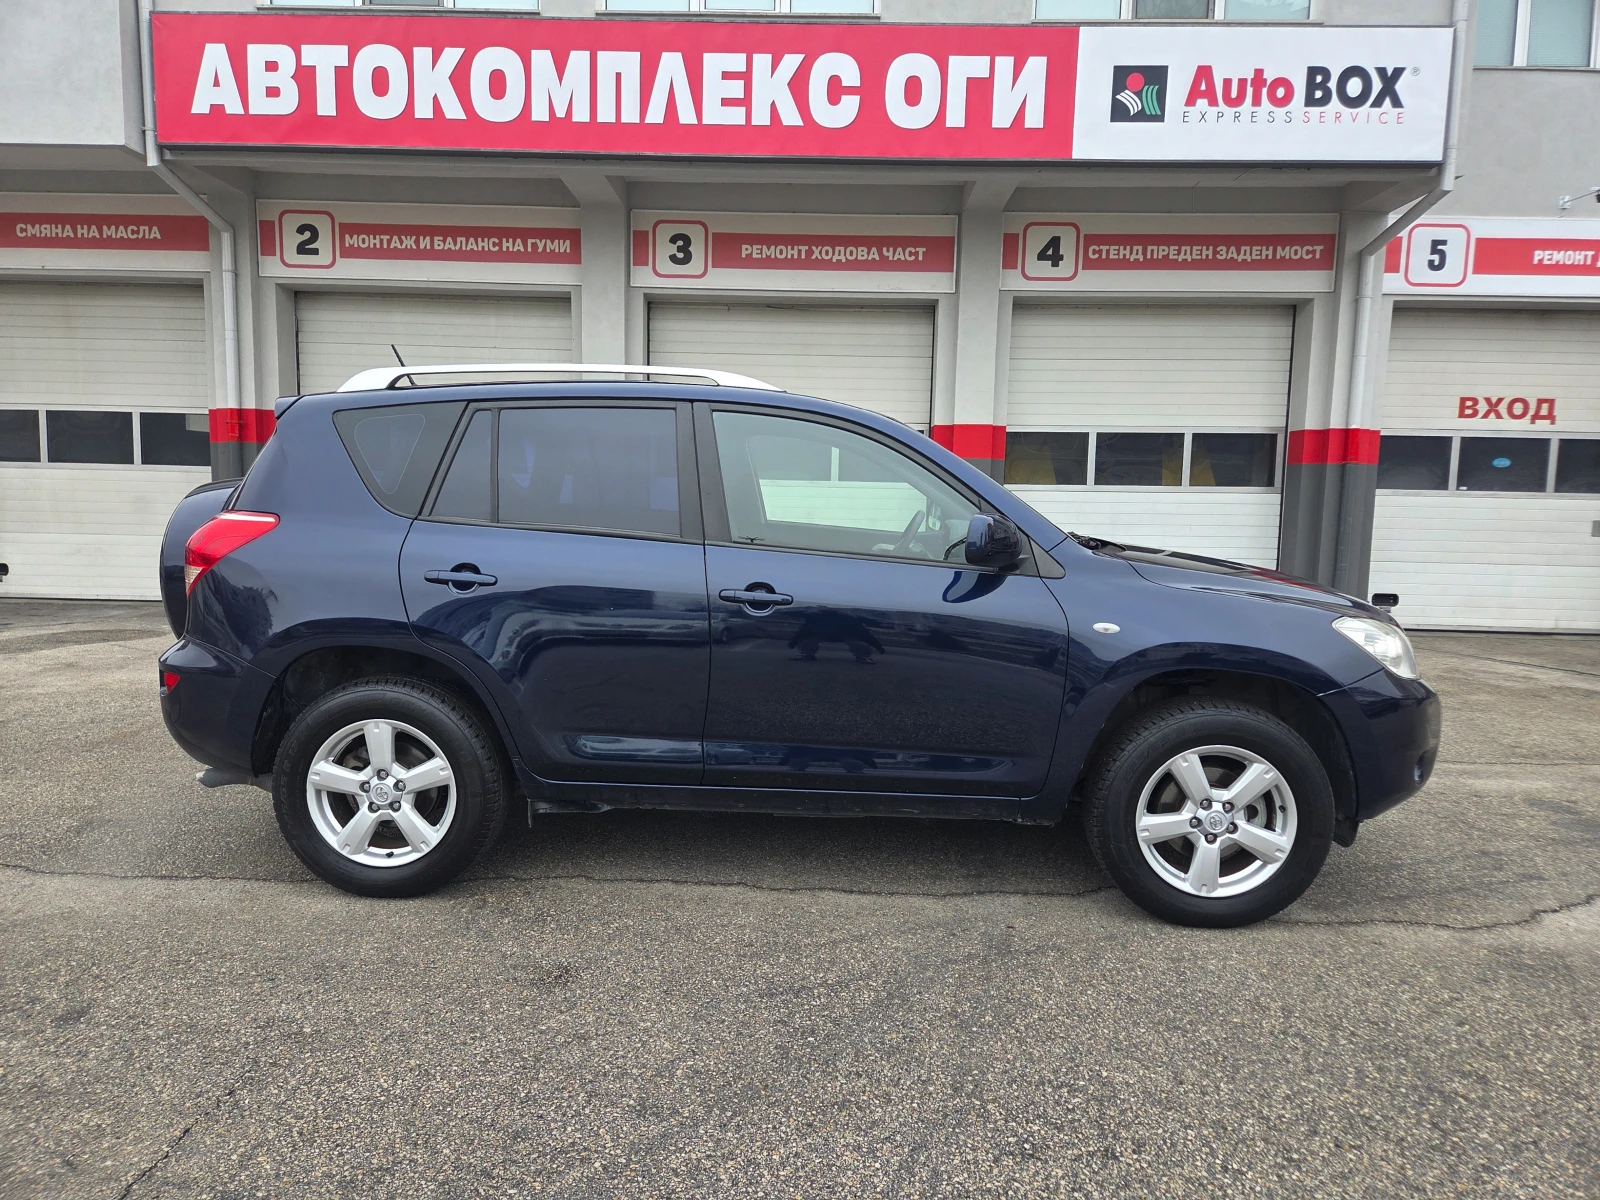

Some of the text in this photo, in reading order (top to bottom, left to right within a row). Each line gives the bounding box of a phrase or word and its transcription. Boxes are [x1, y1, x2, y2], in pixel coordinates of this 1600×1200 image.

[191, 43, 1047, 129] АВТОКОМПЛЕКС ОГИ
[1184, 65, 1406, 108] Auto BOX
[1183, 111, 1403, 124] EXPRESS SERVICE
[16, 224, 161, 239] СМЯНА НА МАСЛА
[296, 224, 319, 255] 2
[345, 234, 570, 253] МОНТАЖ И БАЛАНС НА ГУМИ
[669, 233, 692, 265] 3
[742, 245, 926, 262] РЕМОНТ ХОДОВА ЧАСТ
[1037, 236, 1064, 267] 4
[1089, 246, 1323, 262] СТЕНД ПРЕДЕН ЗАДЕН МОСТ
[1428, 239, 1447, 271] 5
[1533, 250, 1595, 264] РЕМОНТ
[1458, 397, 1556, 425] ВХОД
